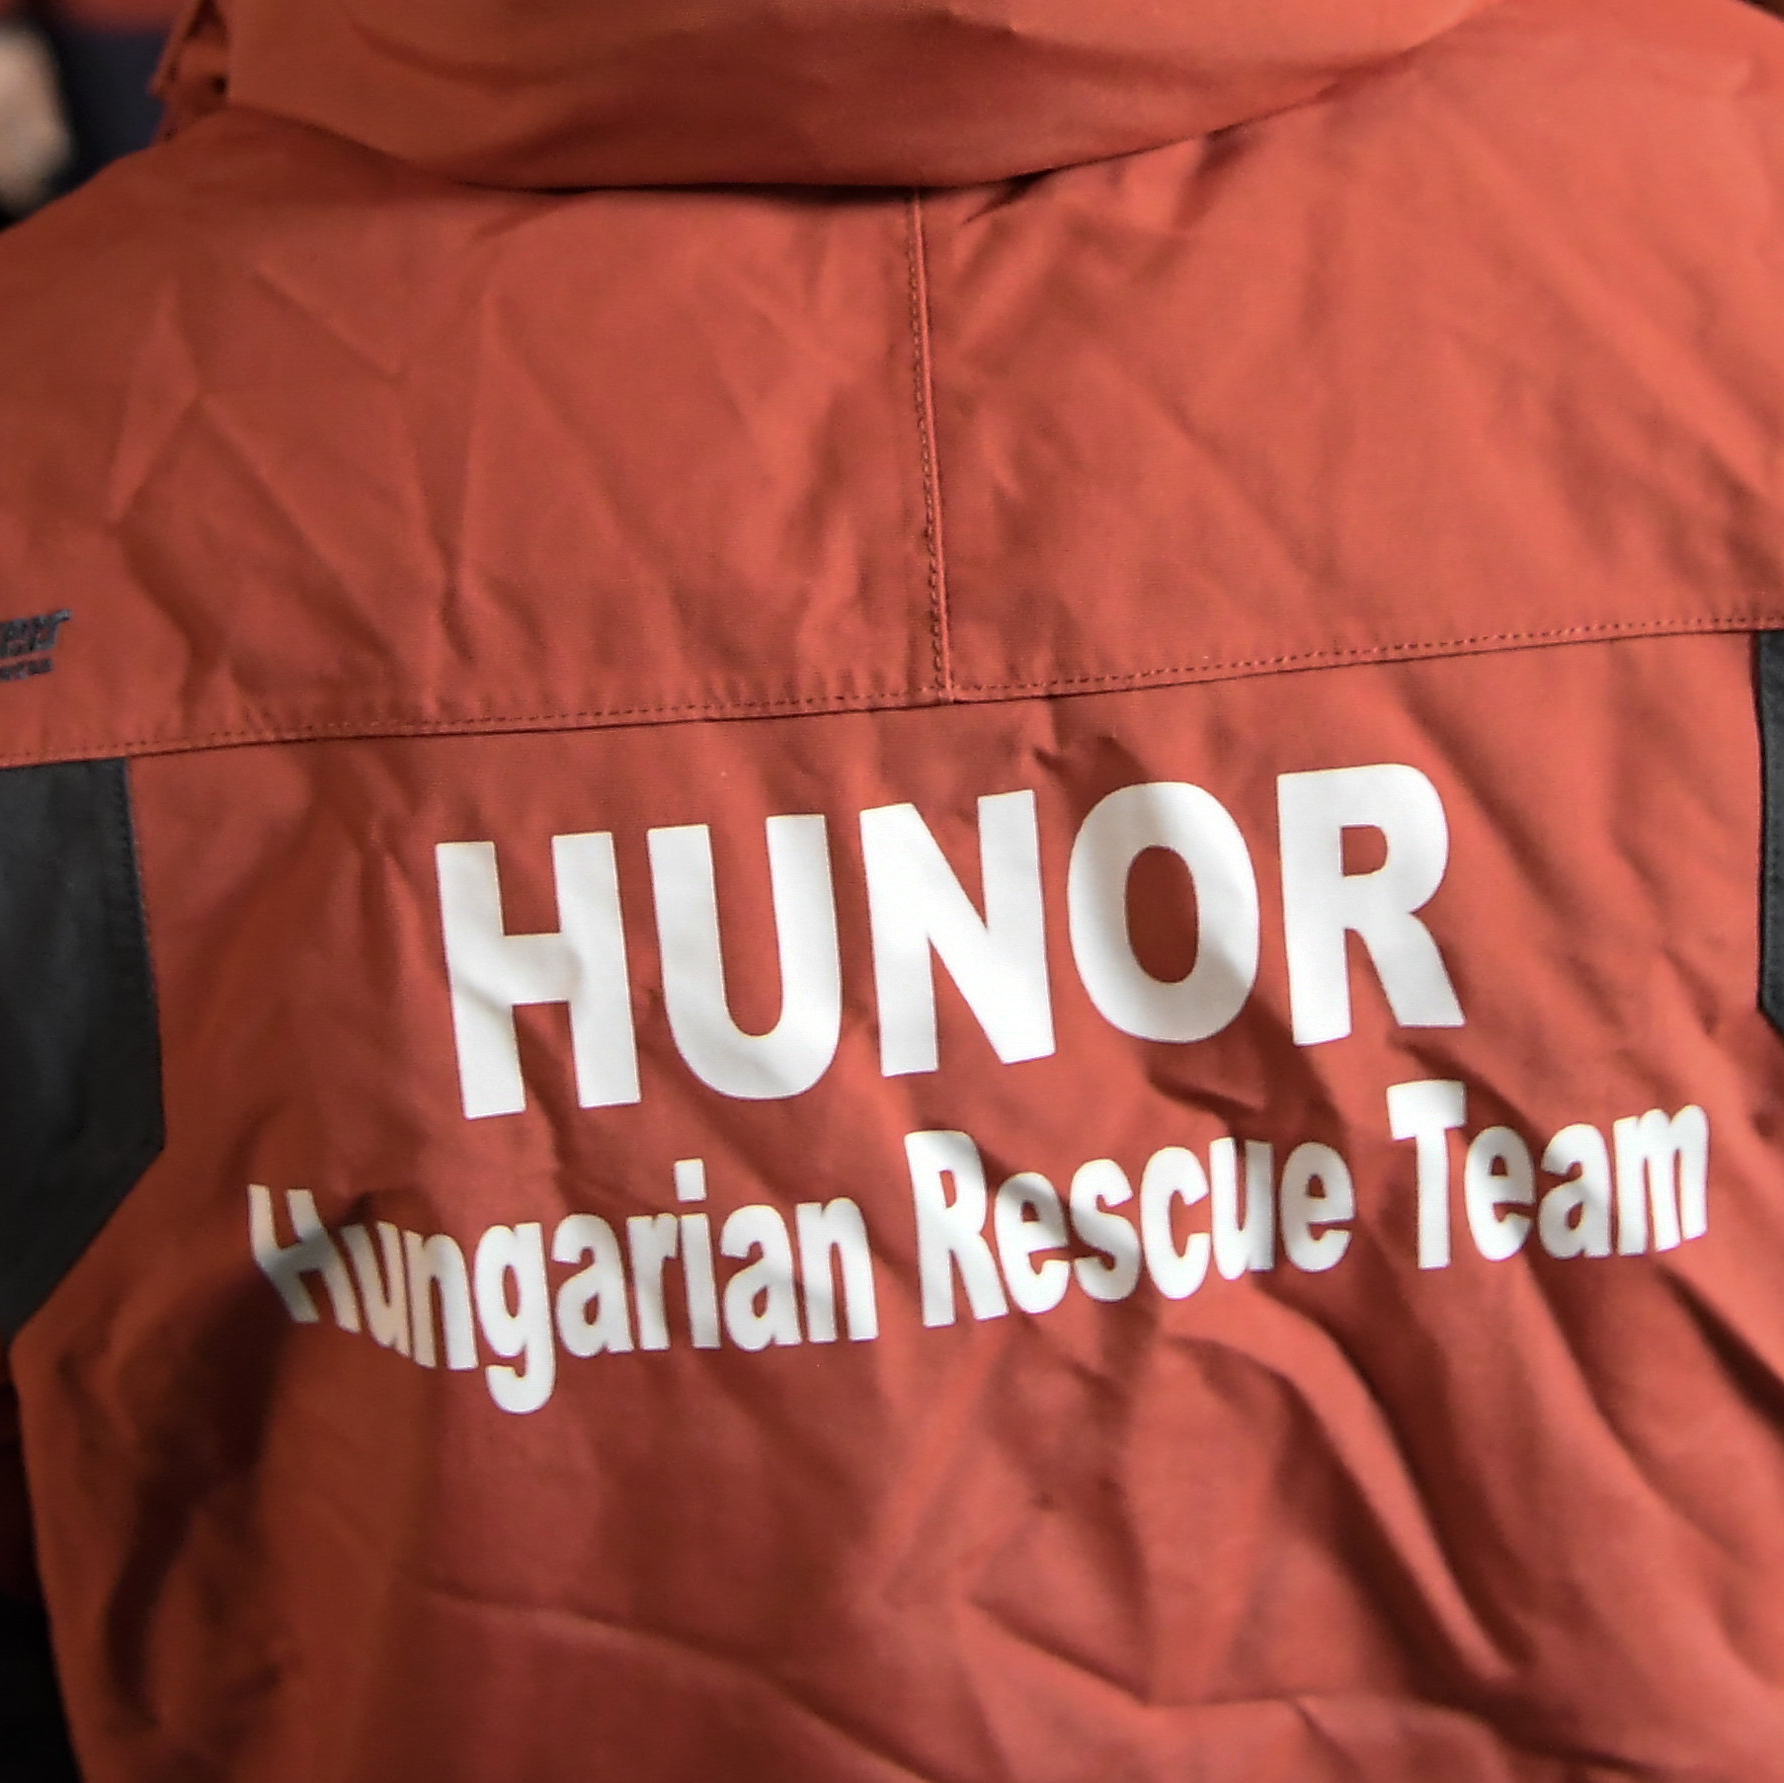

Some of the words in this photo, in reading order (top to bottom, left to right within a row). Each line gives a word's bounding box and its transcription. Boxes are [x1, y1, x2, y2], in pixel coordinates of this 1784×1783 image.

[434, 763, 1467, 1121] HUNOR
[248, 1158, 880, 1415] Hungarian
[901, 1130, 1356, 1329] Rescue
[1385, 1079, 1712, 1270] Team
